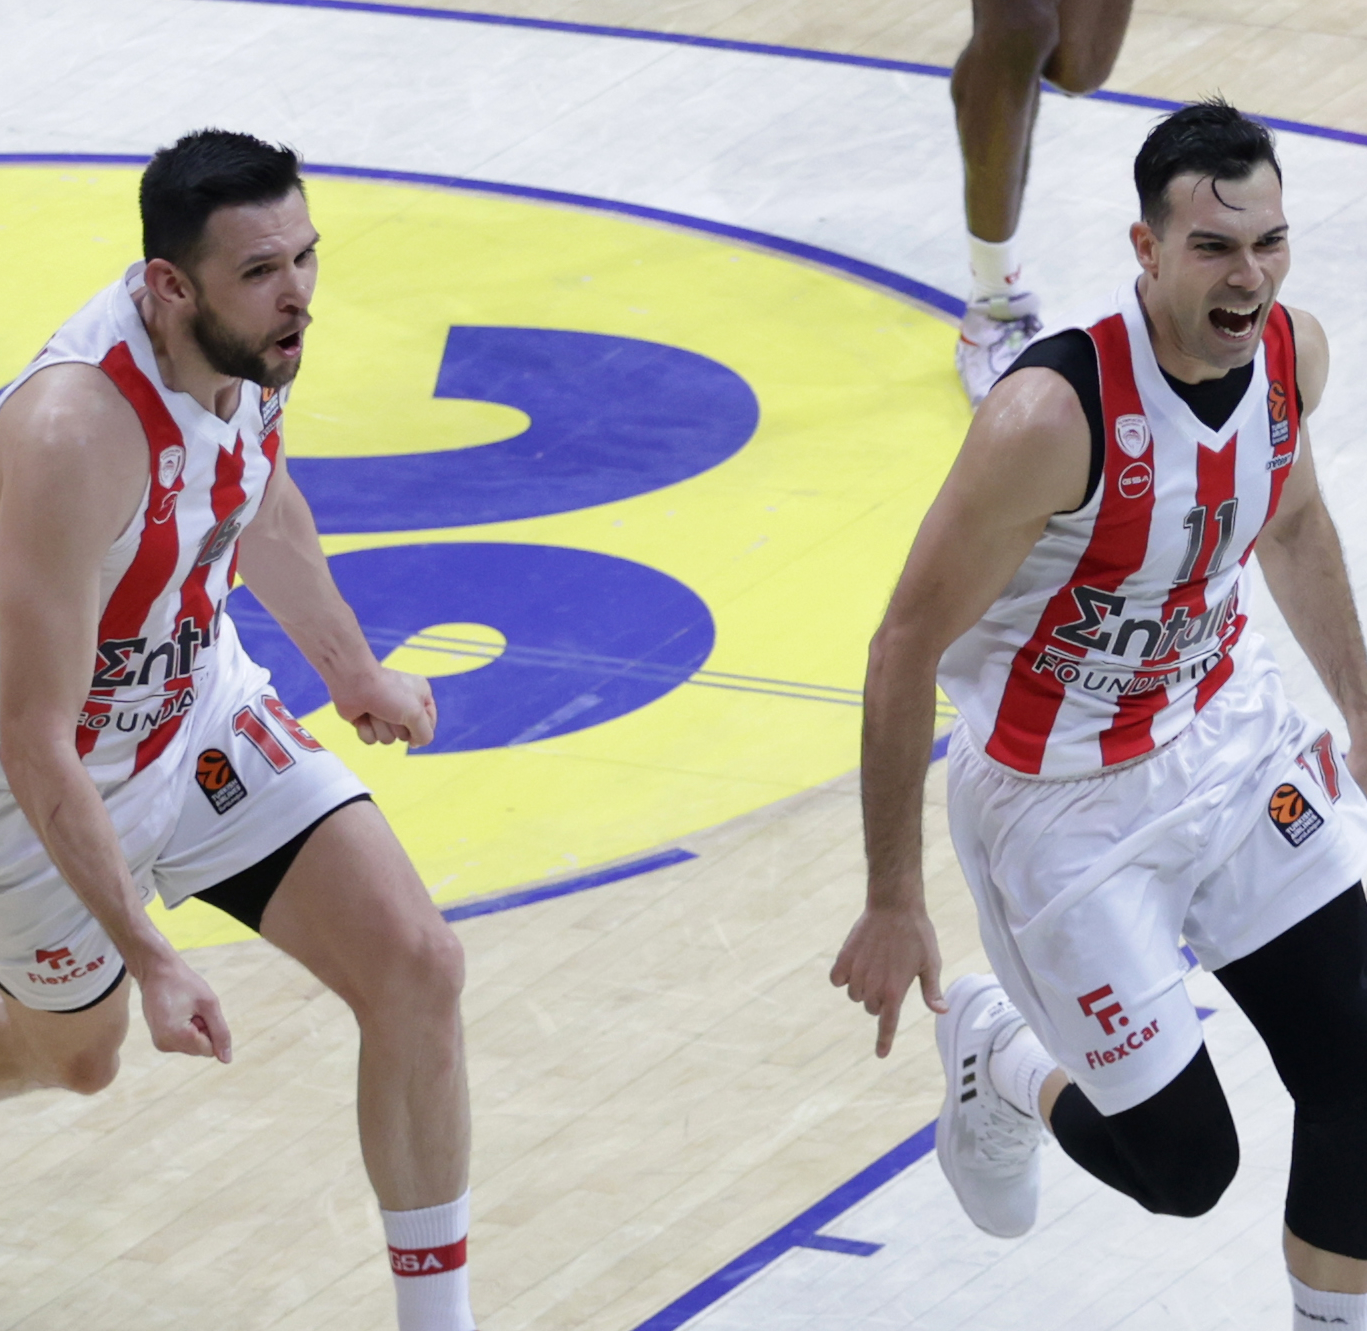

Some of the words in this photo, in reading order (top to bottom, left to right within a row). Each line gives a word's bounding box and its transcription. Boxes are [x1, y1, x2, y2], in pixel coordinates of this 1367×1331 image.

[1121, 474, 1150, 486] GSA
[1172, 497, 1238, 585] 11
[1032, 645, 1234, 696] FOUNDATIO
[1085, 1018, 1161, 1069] FlexCar
